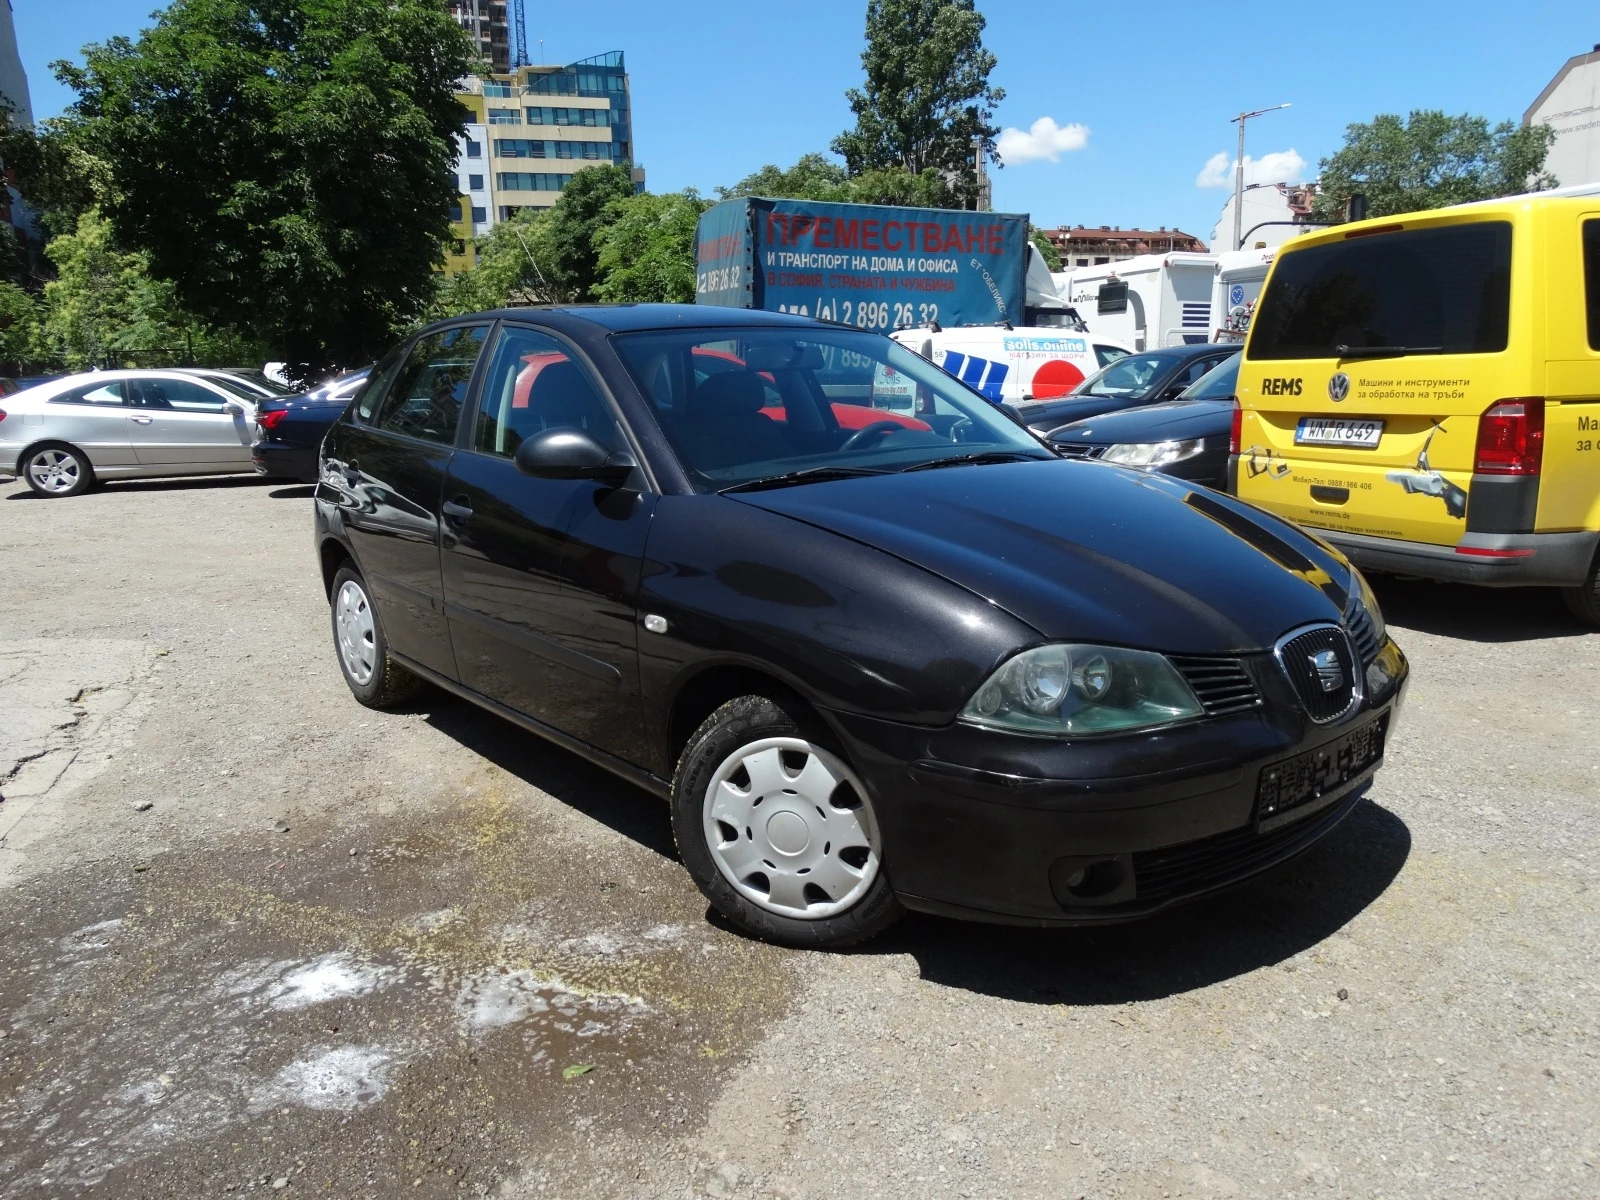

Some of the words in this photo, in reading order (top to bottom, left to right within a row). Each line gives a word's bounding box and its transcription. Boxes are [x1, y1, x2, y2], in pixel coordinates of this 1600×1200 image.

[767, 212, 1005, 255] ПРЕМЕСТВАНЕ
[767, 252, 775, 266] И
[779, 252, 849, 269] ТРАНСПОРТ
[852, 256, 868, 270] НА
[870, 257, 904, 273] ДОМА
[907, 258, 915, 271] И
[918, 258, 958, 273] ОФИСА
[730, 265, 740, 288] 32
[768, 271, 775, 286] В
[829, 274, 886, 290] СТРАНАТА
[890, 278, 897, 290] И
[902, 277, 956, 292] ЧУЖБИНА
[842, 301, 852, 324] 2
[857, 302, 888, 328] 896
[893, 303, 914, 329] 26
[919, 303, 938, 326] 32
[1008, 337, 1084, 351] solis.online
[1261, 377, 1302, 396] REMS
[1359, 378, 1394, 387] Машини
[1405, 379, 1470, 389] инструменти
[1357, 390, 1367, 398] за
[1369, 389, 1415, 399] обработка
[1418, 391, 1429, 399] на
[1432, 391, 1465, 400] тръби
[1308, 421, 1328, 438] WN
[1332, 422, 1345, 439] R
[1345, 422, 1375, 441] 649
[1576, 440, 1592, 451] за
[1309, 509, 1350, 519] www.rems.de
